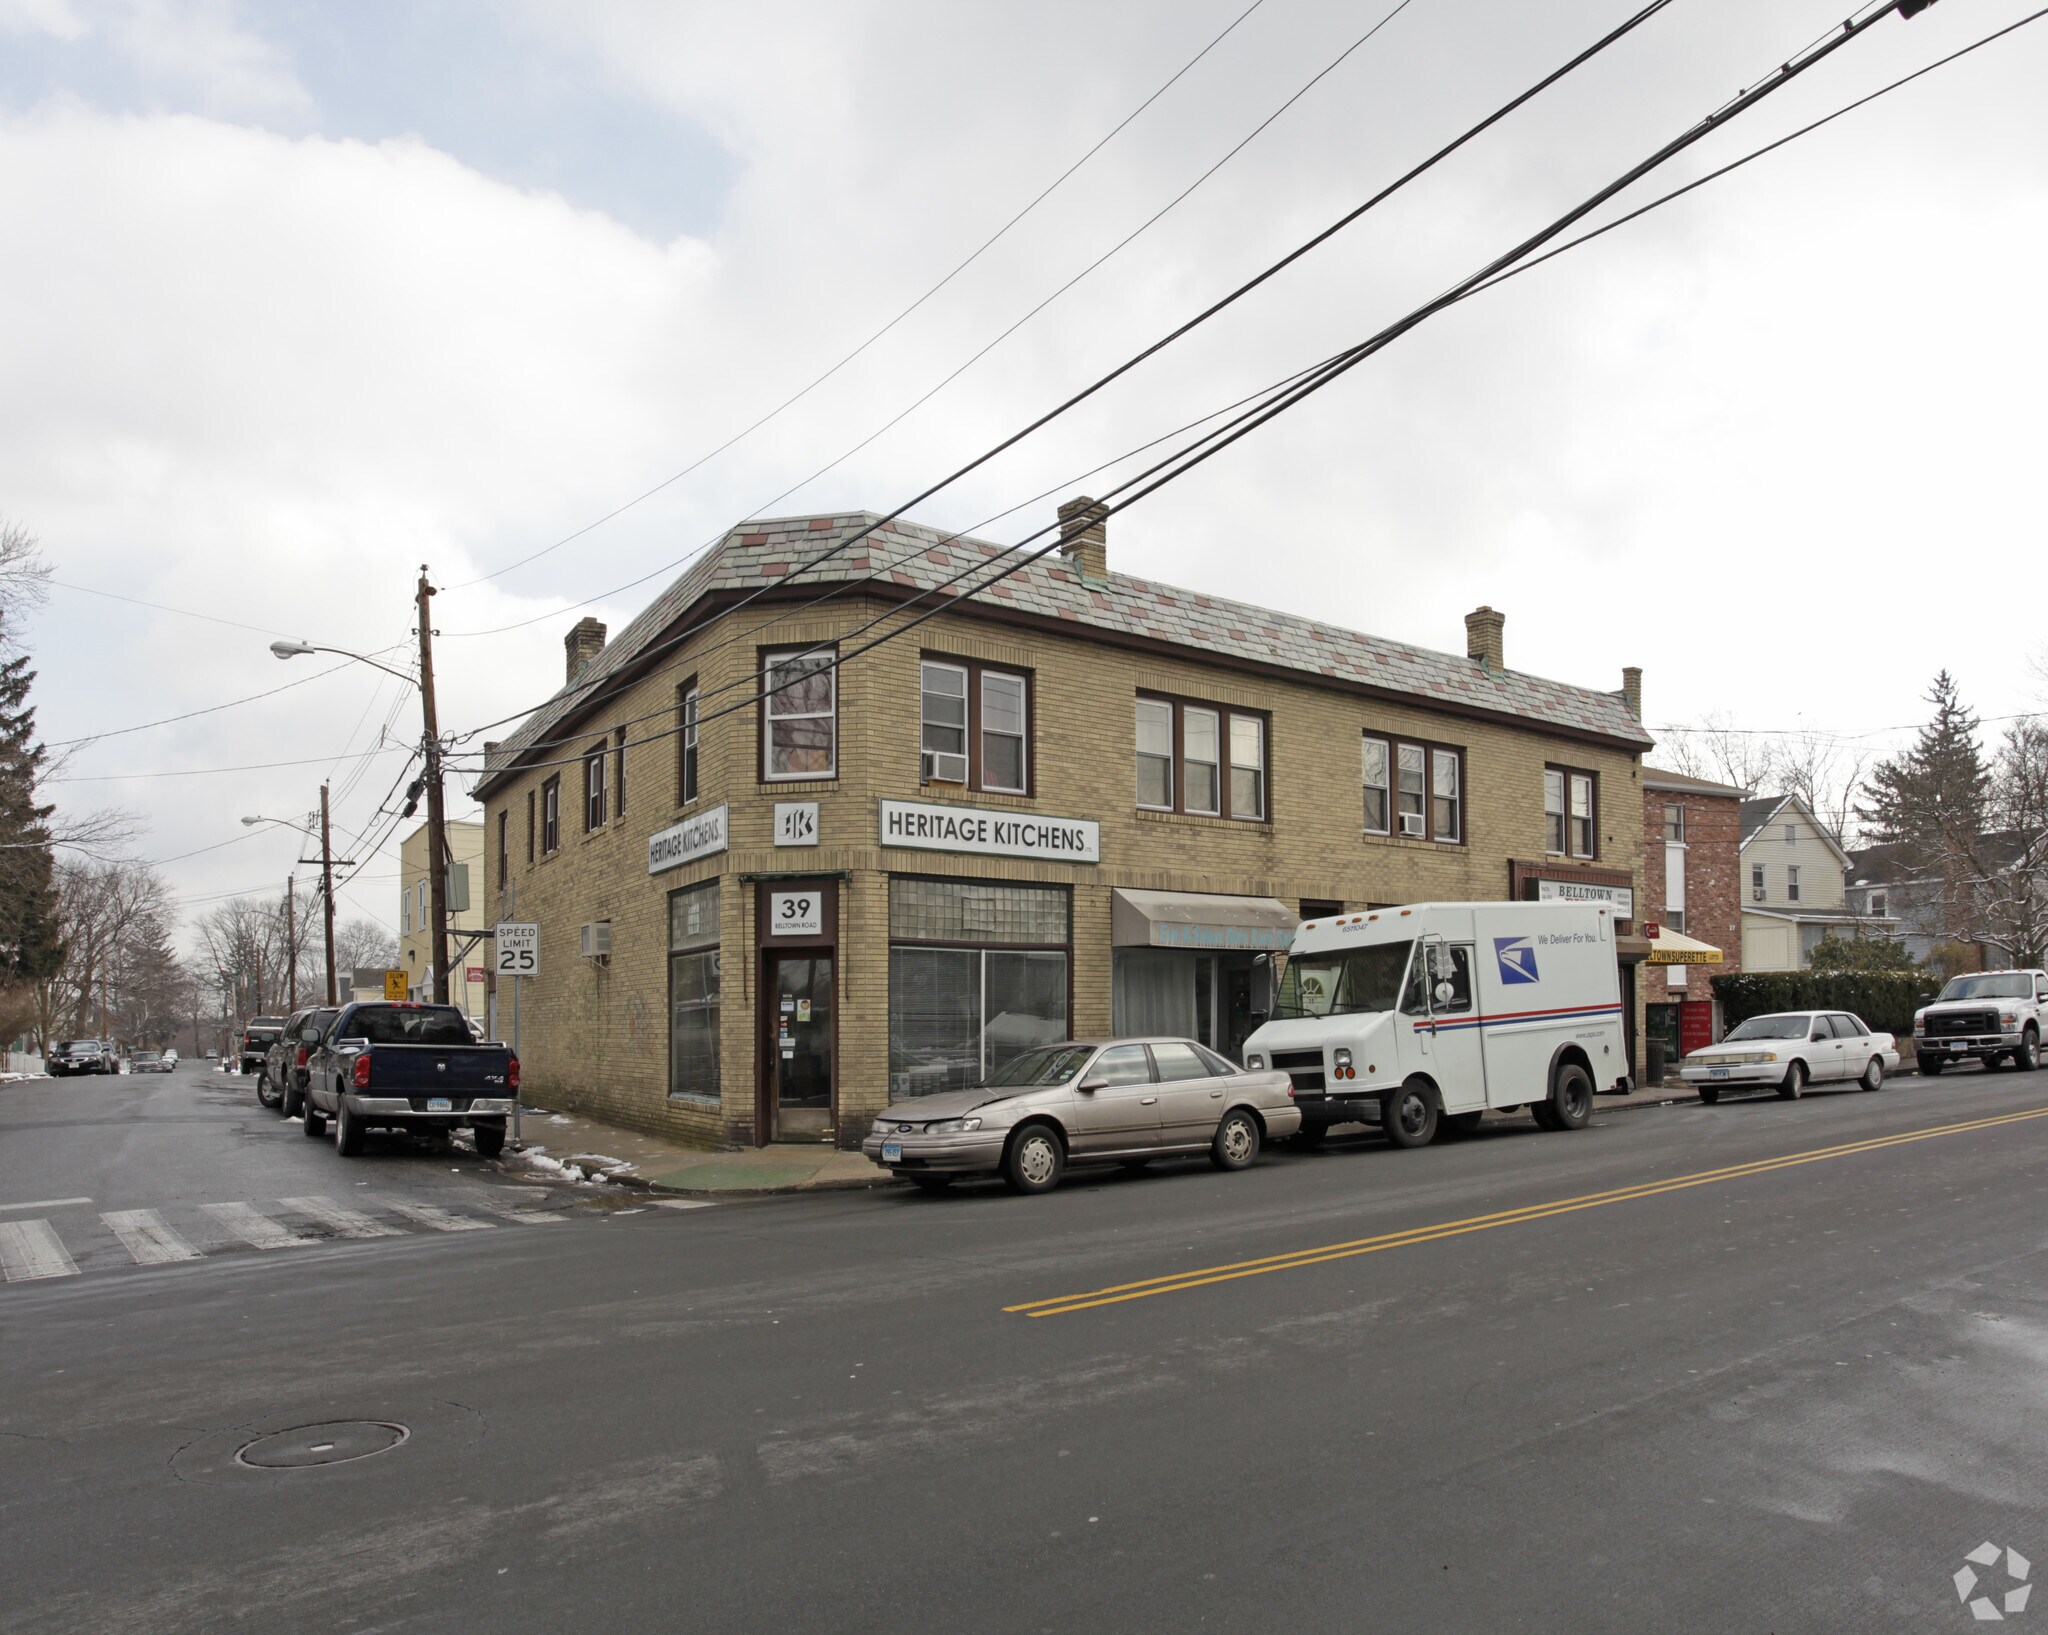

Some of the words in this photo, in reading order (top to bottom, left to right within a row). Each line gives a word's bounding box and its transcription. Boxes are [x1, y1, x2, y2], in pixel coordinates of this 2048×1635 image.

[889, 811, 987, 842] HERITAGE
[994, 821, 1085, 852] KITCHENS
[650, 834, 682, 865] HERITAGE
[682, 818, 719, 852] KITCHENS
[1558, 885, 1613, 901] BELLTOWN
[781, 898, 811, 919] 39
[499, 928, 536, 937] SPEED
[801, 921, 818, 929] ROAD
[503, 939, 531, 948] LIMIT
[1538, 934, 1549, 945] We
[1550, 934, 1572, 945] Deliver
[1573, 933, 1584, 943] For
[500, 950, 535, 970] 25
